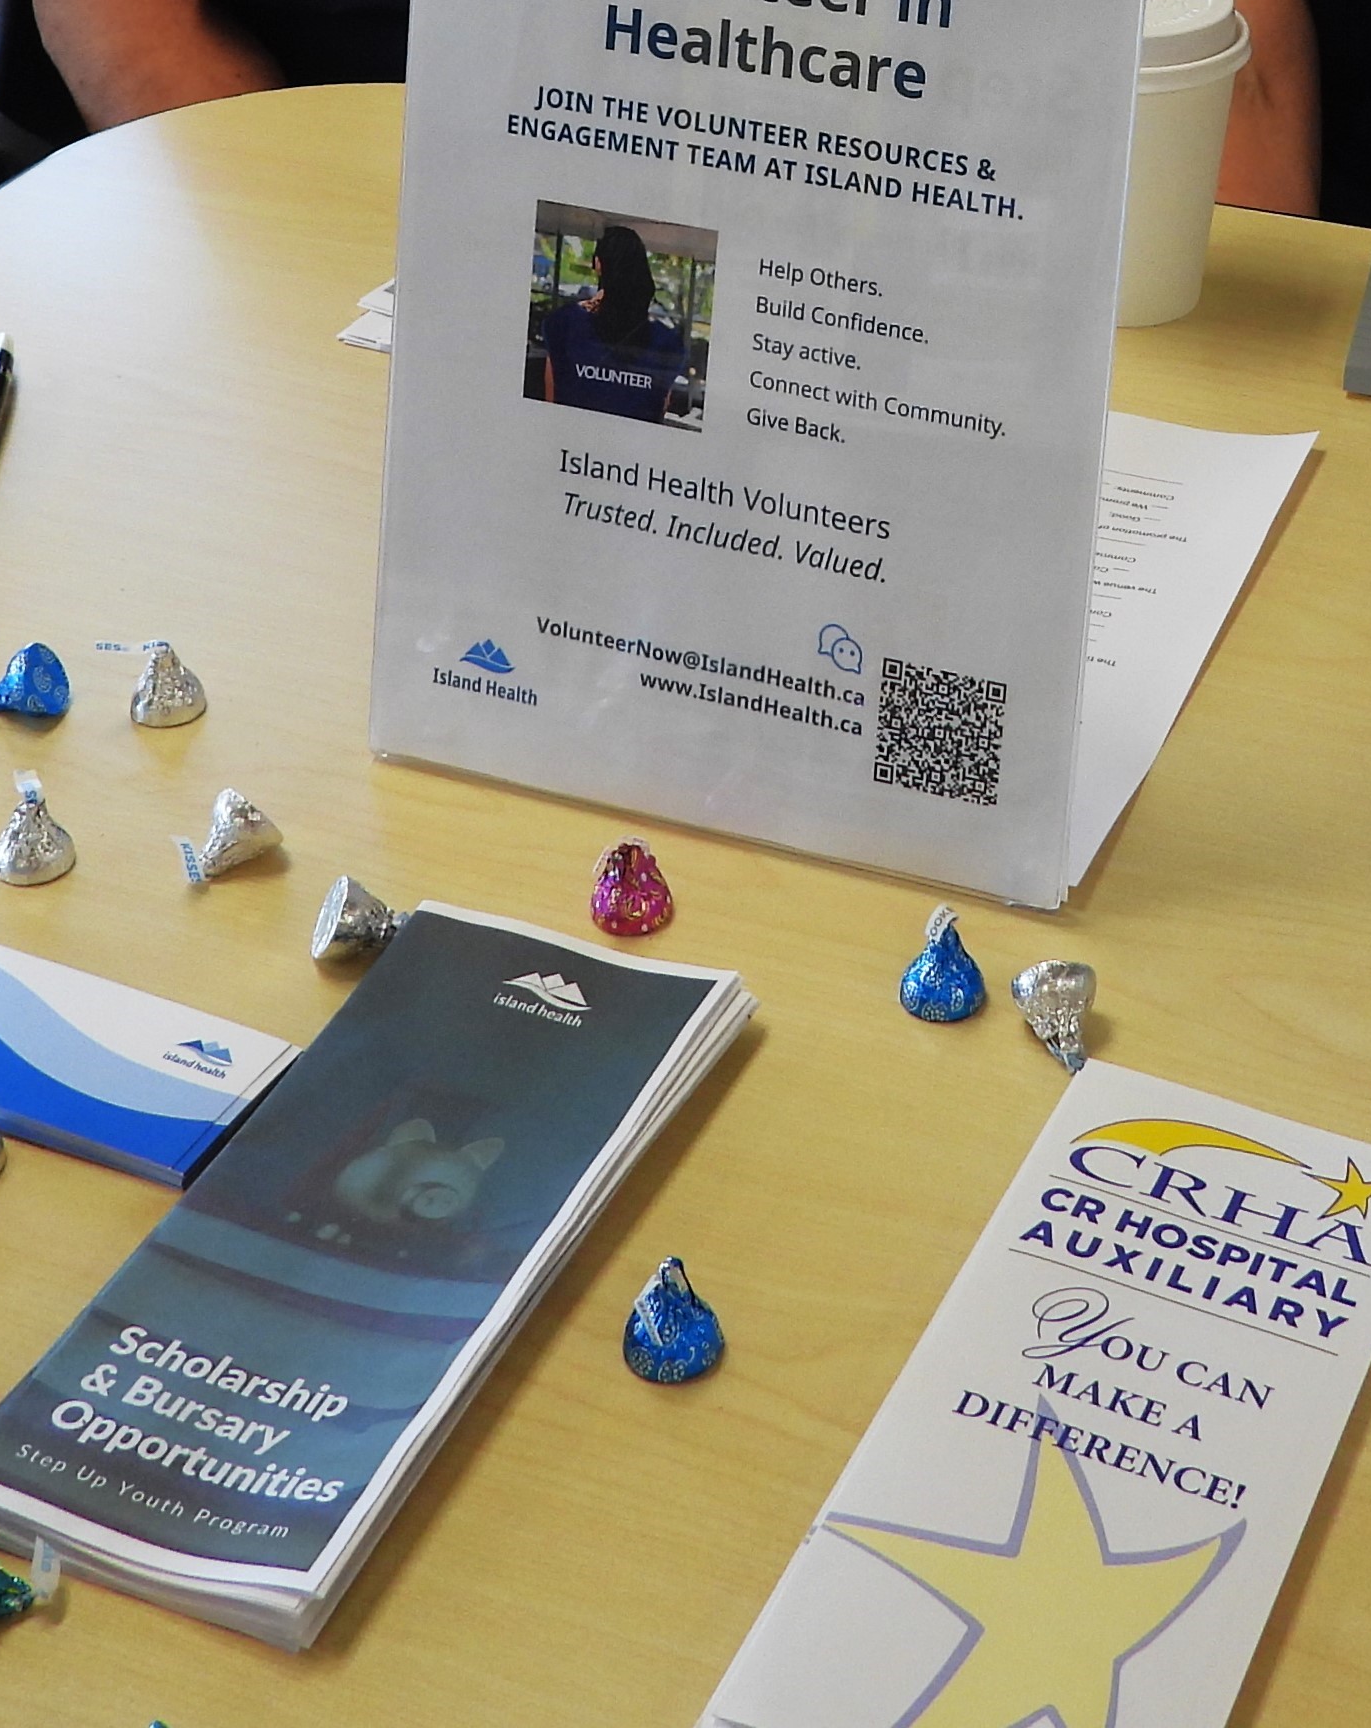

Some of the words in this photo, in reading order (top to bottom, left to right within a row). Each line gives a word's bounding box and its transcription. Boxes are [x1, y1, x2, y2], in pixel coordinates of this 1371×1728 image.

[605, 4, 926, 99] Healthcare
[507, 113, 679, 161] ENGAGEMENT
[686, 143, 756, 174] TEAM
[763, 157, 797, 181] AT
[804, 163, 902, 198] ISLAND
[911, 181, 1023, 220] HEALTH.
[533, 85, 593, 114] JOIN
[602, 96, 649, 123] THE
[656, 105, 808, 150] VOLUNTEER
[817, 131, 968, 176] RESOURCES
[976, 158, 996, 181] &
[756, 295, 805, 321] Build
[811, 306, 928, 344] Confidence.
[759, 258, 804, 287] Help
[810, 267, 882, 297] Others.
[575, 363, 652, 389] VOLUNTEER
[752, 333, 794, 361] Stay
[798, 345, 861, 370] active.
[746, 407, 789, 431] Give
[795, 416, 845, 443] Back.
[749, 370, 830, 402] Connect
[835, 389, 877, 411] with
[884, 396, 1005, 440] Community.
[559, 448, 639, 486] Island
[648, 467, 733, 507] Health
[743, 486, 890, 539] Volunteers
[564, 492, 657, 534] Trusted.
[666, 515, 782, 560] Included.
[796, 540, 885, 583] Valued.
[432, 667, 482, 693] Island
[485, 679, 537, 706] Health
[536, 616, 865, 706] VolunteerNow@IslandHealth.ca
[640, 673, 862, 736] www.IslandHealth.ca
[493, 992, 539, 1014] island
[537, 1004, 583, 1028] health
[163, 1051, 195, 1068] island
[194, 1062, 226, 1079] health
[1019, 1221, 1350, 1338] AUXILIARY
[1041, 1188, 1107, 1224] CR
[1115, 1209, 1358, 1307] HOSPITAL
[80, 1363, 118, 1397] &
[121, 1375, 291, 1455] Bursary
[108, 1326, 348, 1422] Scholarship
[1033, 1363, 1165, 1428] MAKE
[1172, 1413, 1203, 1442] A
[1175, 1360, 1275, 1410] CAN
[16, 1444, 67, 1473] Step
[76, 1465, 107, 1488] Up
[118, 1480, 184, 1517] Youth
[193, 1508, 289, 1538] Program
[51, 1401, 345, 1502] Opportunities
[952, 1390, 1247, 1511] DIFFERENCE!
